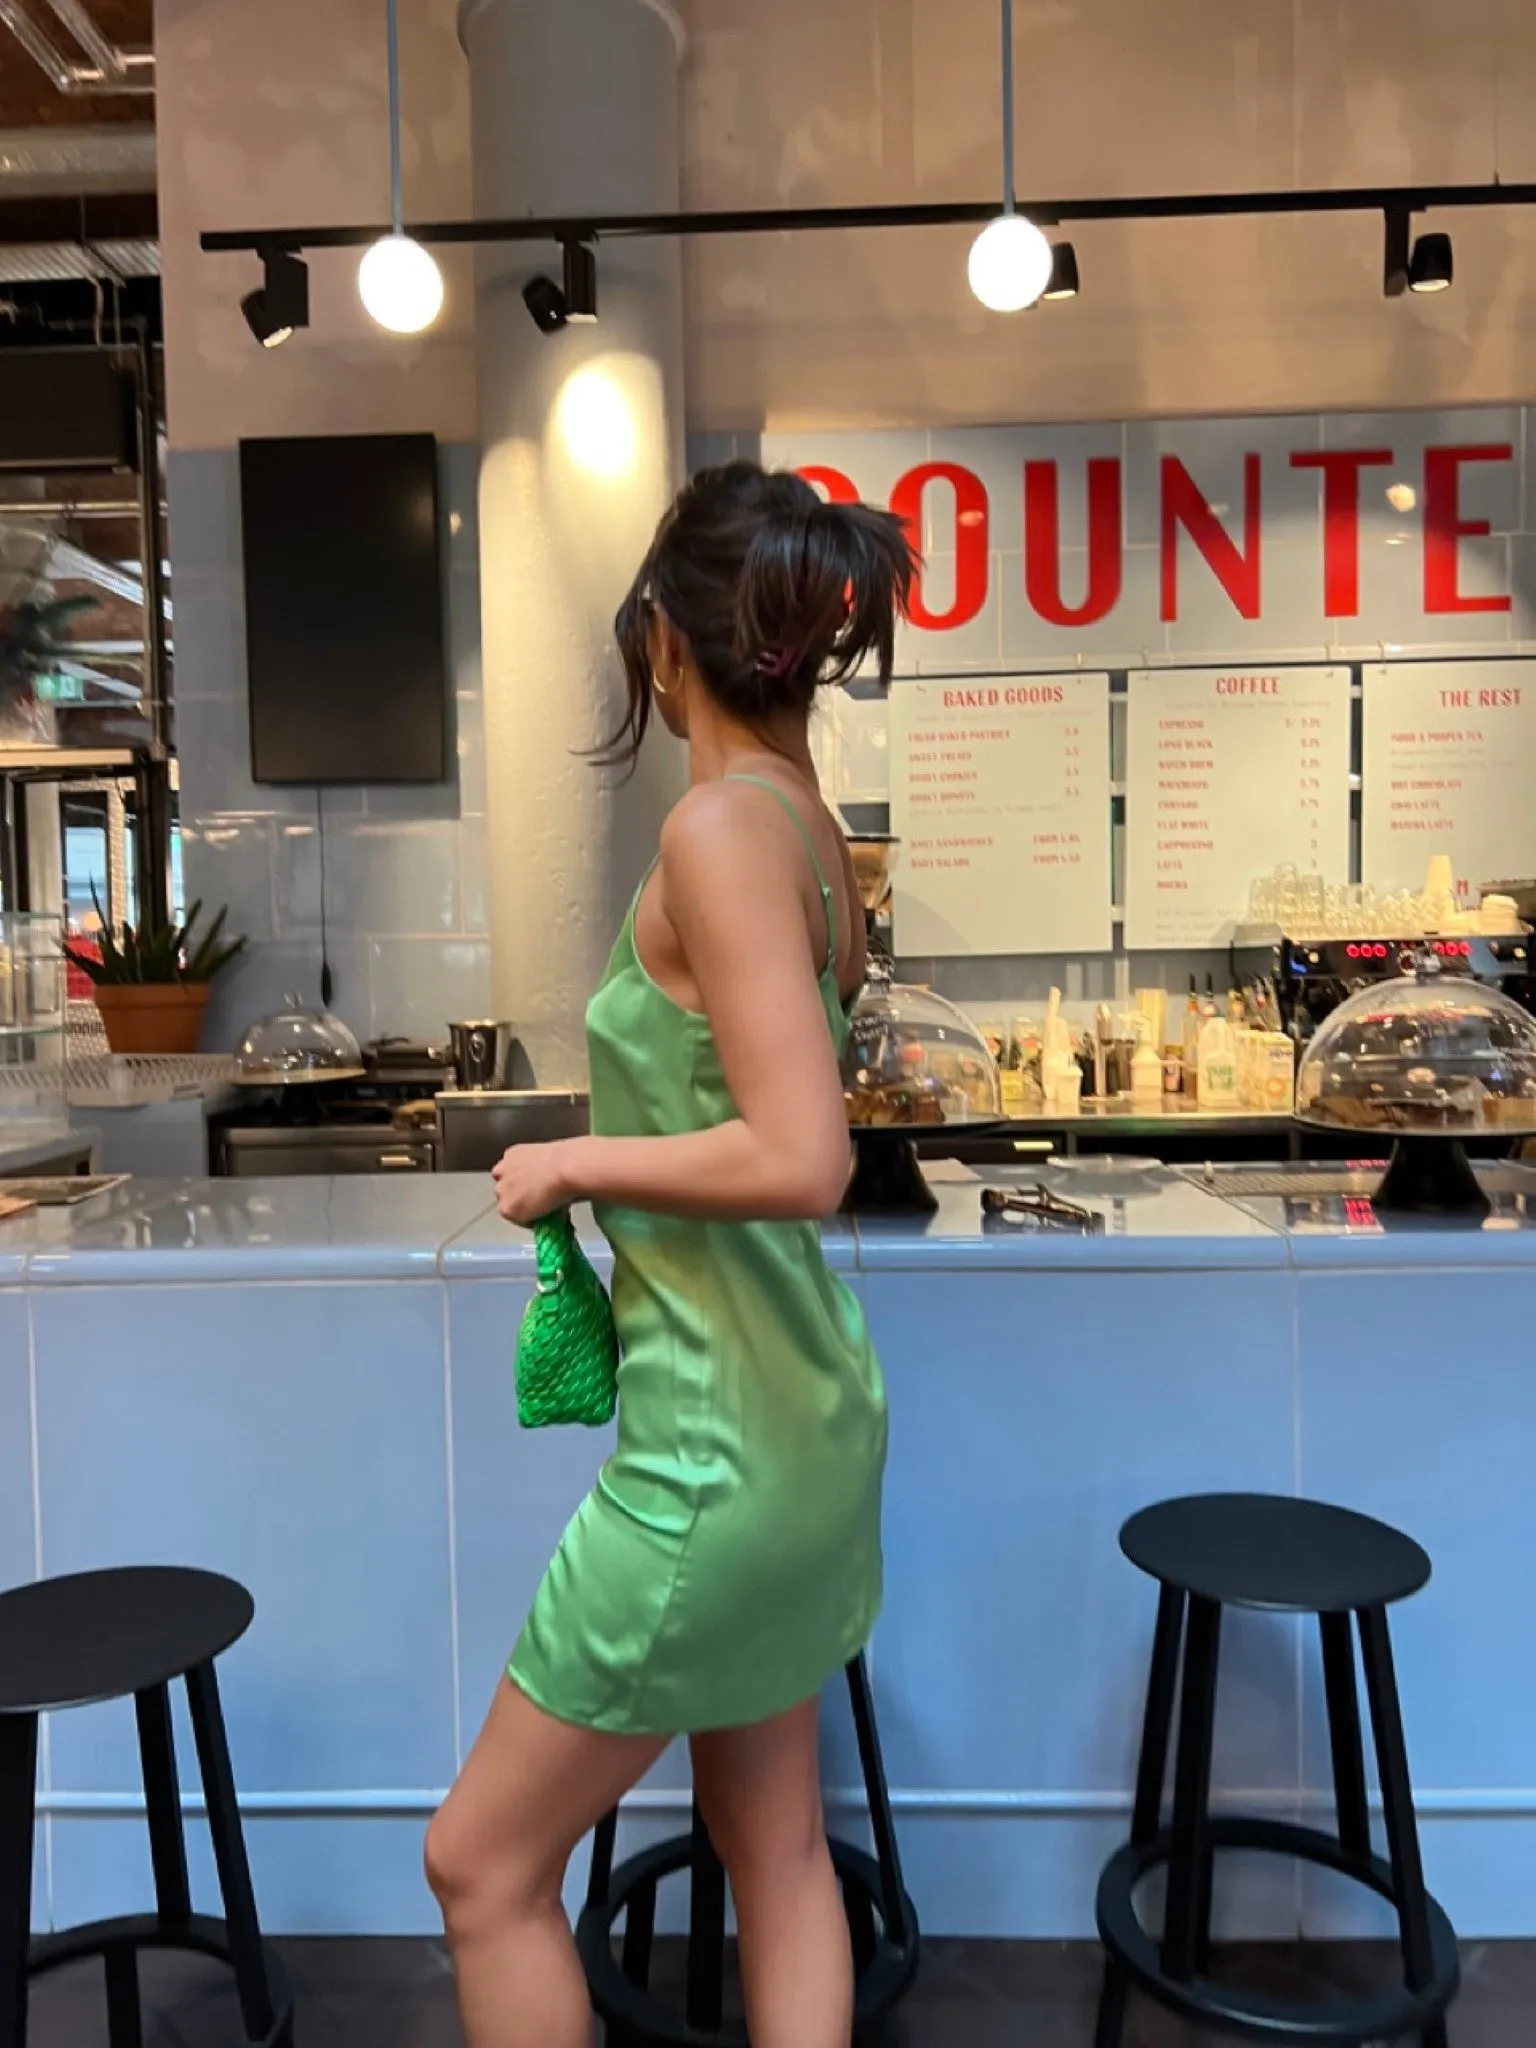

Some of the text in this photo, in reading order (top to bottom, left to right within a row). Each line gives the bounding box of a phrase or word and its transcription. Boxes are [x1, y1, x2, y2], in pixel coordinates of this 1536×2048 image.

[795, 444, 1512, 630] OUNTE
[1216, 676, 1280, 695] COFFEE
[943, 686, 1063, 708] BAKED GOODS
[1440, 688, 1521, 707] THE REST
